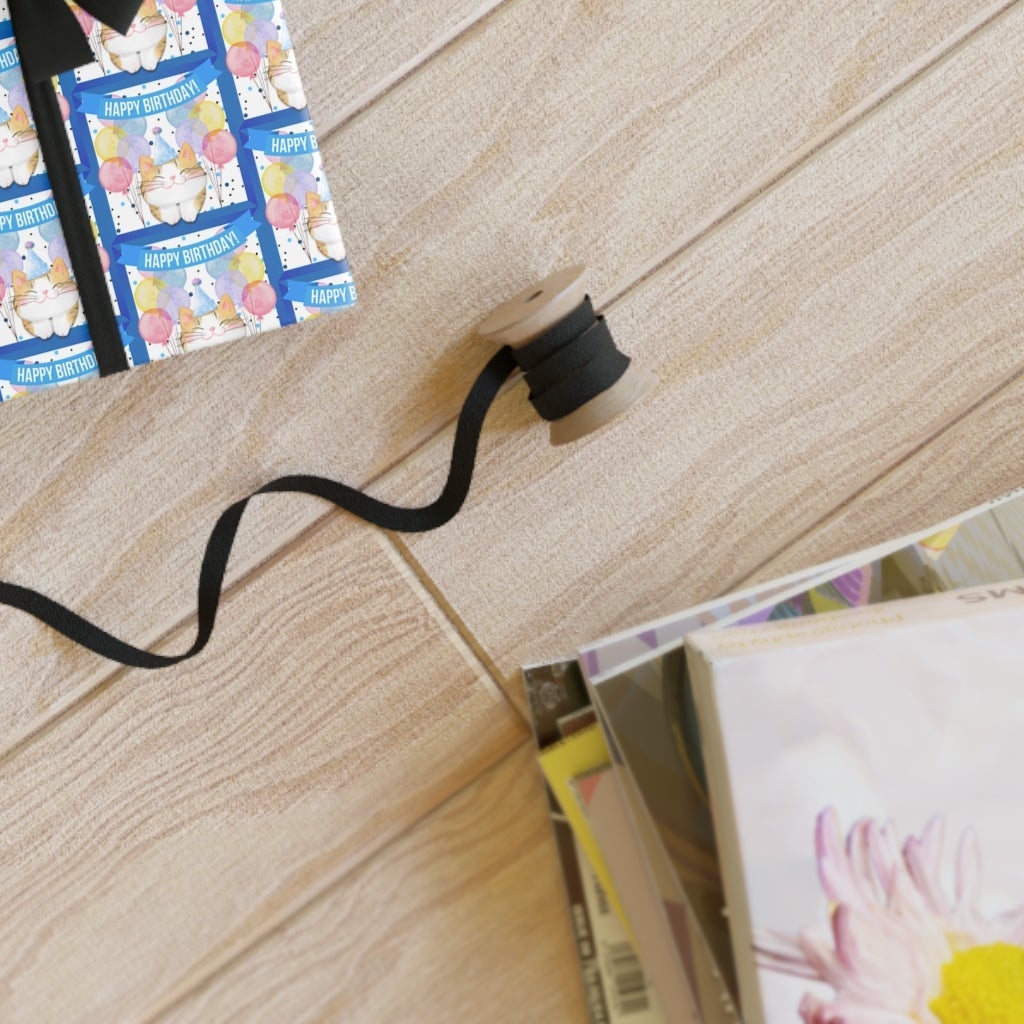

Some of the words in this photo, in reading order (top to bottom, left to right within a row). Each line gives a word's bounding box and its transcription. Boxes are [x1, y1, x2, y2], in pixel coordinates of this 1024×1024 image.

[104, 100, 140, 116] HAPPY
[142, 79, 200, 113] BIRTHDAY!
[272, 136, 307, 152] HAPPY
[15, 202, 56, 228] BIRTHD
[144, 252, 180, 268] HAPPY
[182, 231, 240, 265] BIRTHDAY!
[311, 288, 346, 304] HAPPY
[17, 366, 53, 382] HAPPY
[55, 354, 96, 378] BIRTHD
